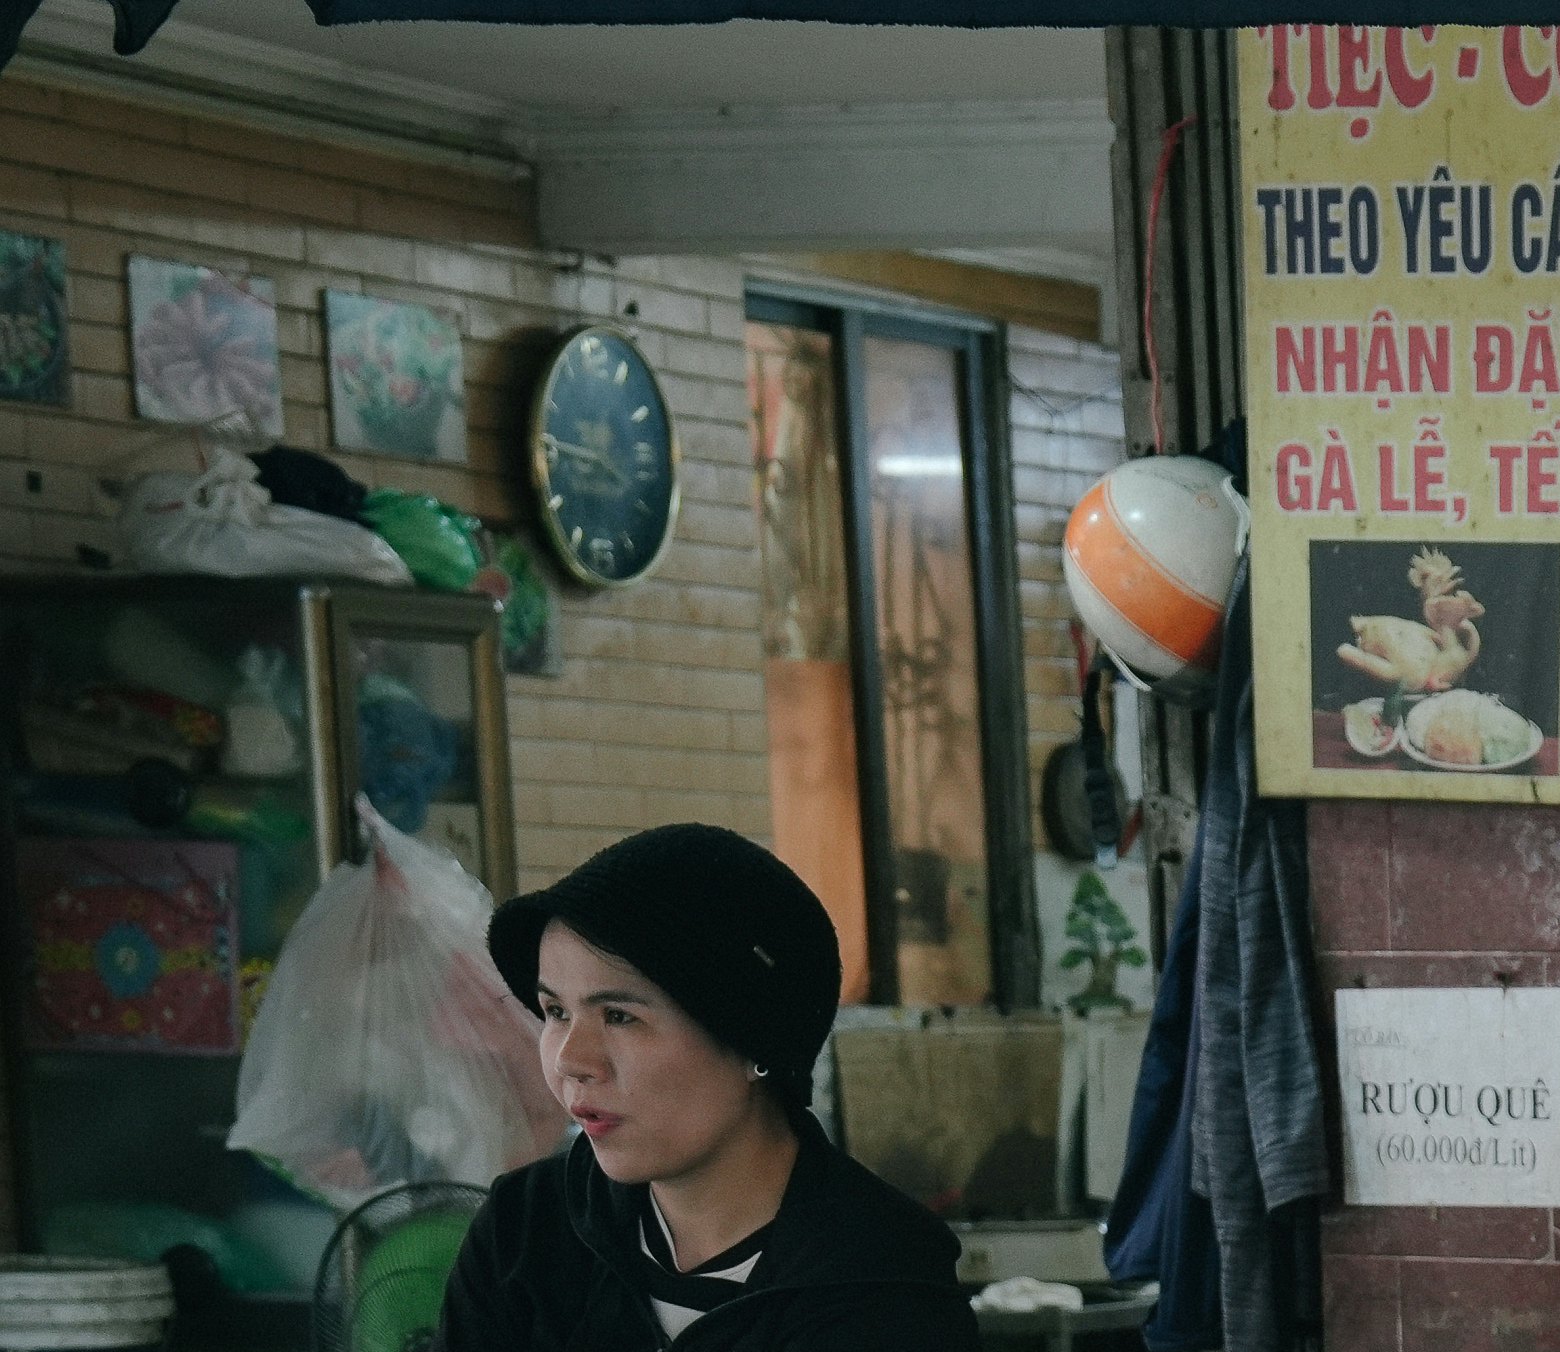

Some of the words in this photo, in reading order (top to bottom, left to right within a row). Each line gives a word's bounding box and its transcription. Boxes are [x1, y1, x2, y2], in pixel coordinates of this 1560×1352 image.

[1257, 187, 1378, 274] THEO
[1396, 166, 1492, 274] YÊU
[1275, 309, 1450, 409] NHẬN
[1276, 428, 1357, 512] GÀ
[1379, 417, 1467, 522] LỄ,
[1361, 1078, 1463, 1124] RƯỢU
[1477, 1078, 1550, 1126] QUÊ
